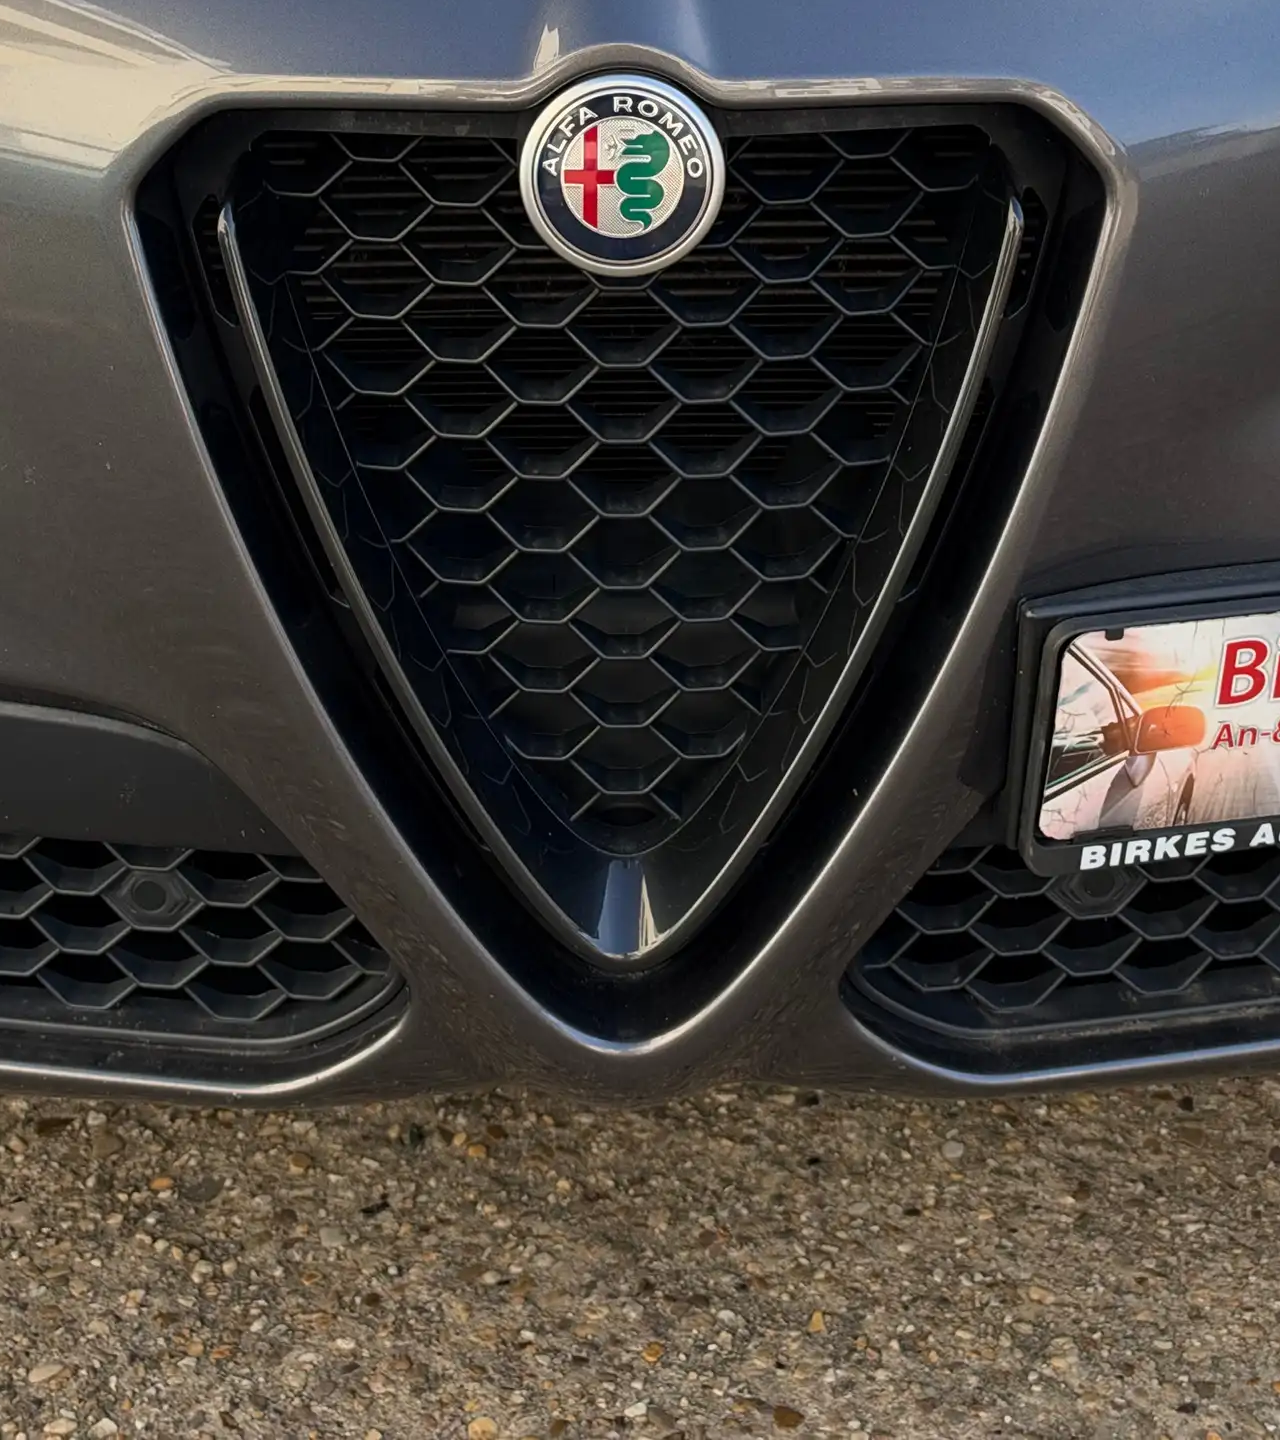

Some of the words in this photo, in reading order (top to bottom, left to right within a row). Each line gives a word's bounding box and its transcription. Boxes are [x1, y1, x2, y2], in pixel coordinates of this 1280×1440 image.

[542, 105, 598, 177] ALFA
[613, 96, 704, 179] ROMEO
[1079, 826, 1236, 871] BIRKES
